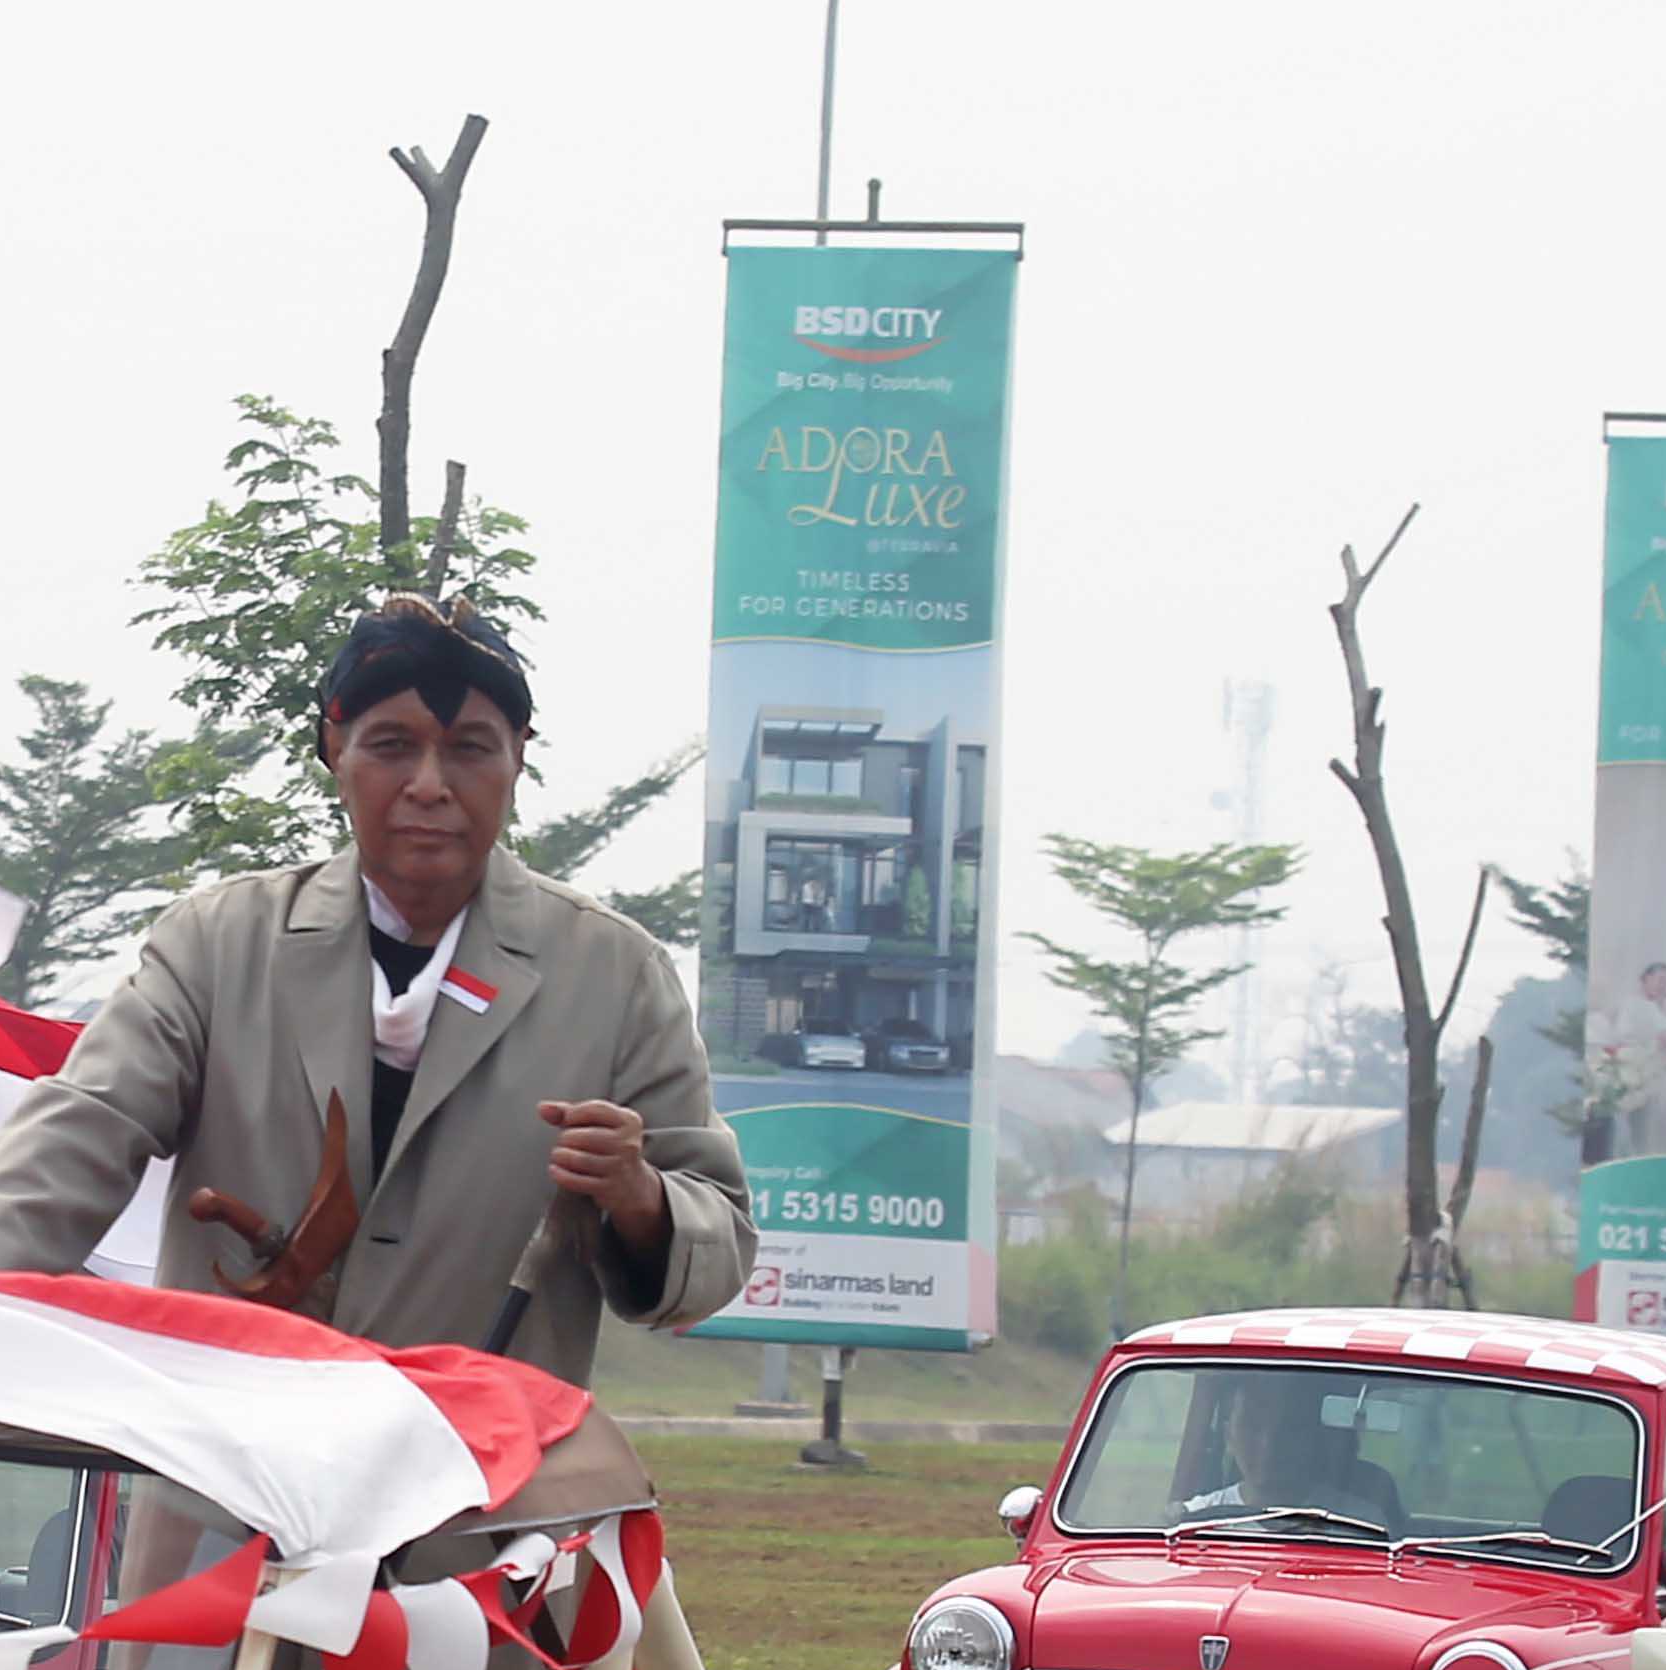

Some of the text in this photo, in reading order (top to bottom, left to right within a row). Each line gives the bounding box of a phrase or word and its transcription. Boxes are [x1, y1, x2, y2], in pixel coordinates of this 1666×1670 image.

[795, 306, 943, 338] BSDCITY
[755, 426, 956, 477] ADORA
[788, 447, 968, 528] Luxe
[797, 570, 910, 592] TIMELESS
[738, 596, 970, 622] FOR GENERATIONS
[782, 1190, 858, 1222] 5315
[868, 1195, 944, 1227] 9000
[1598, 1223, 1650, 1250] 021
[784, 1268, 933, 1296] sinarmas land
